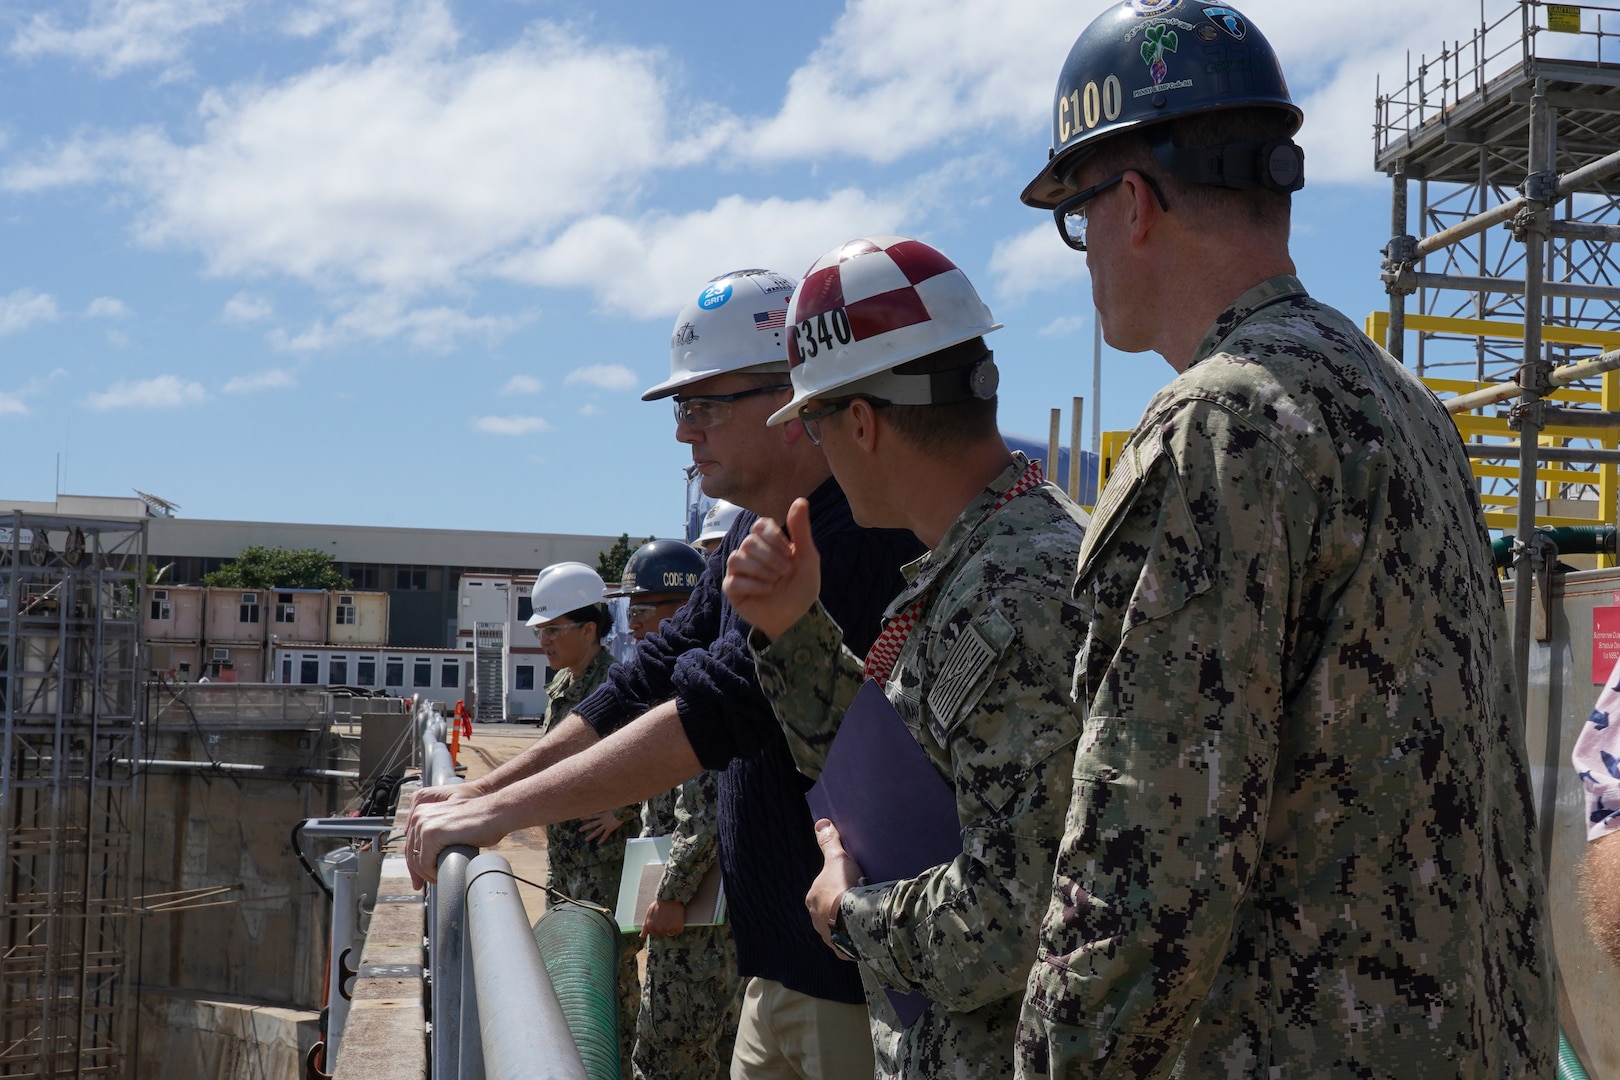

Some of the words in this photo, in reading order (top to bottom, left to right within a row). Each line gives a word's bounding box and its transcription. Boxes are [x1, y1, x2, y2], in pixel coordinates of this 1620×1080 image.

[1058, 74, 1122, 144] C100
[704, 283, 725, 299] 23
[703, 294, 726, 307] GRIT
[791, 307, 852, 364] C340
[663, 571, 684, 588] CODE
[685, 572, 698, 587] 900
